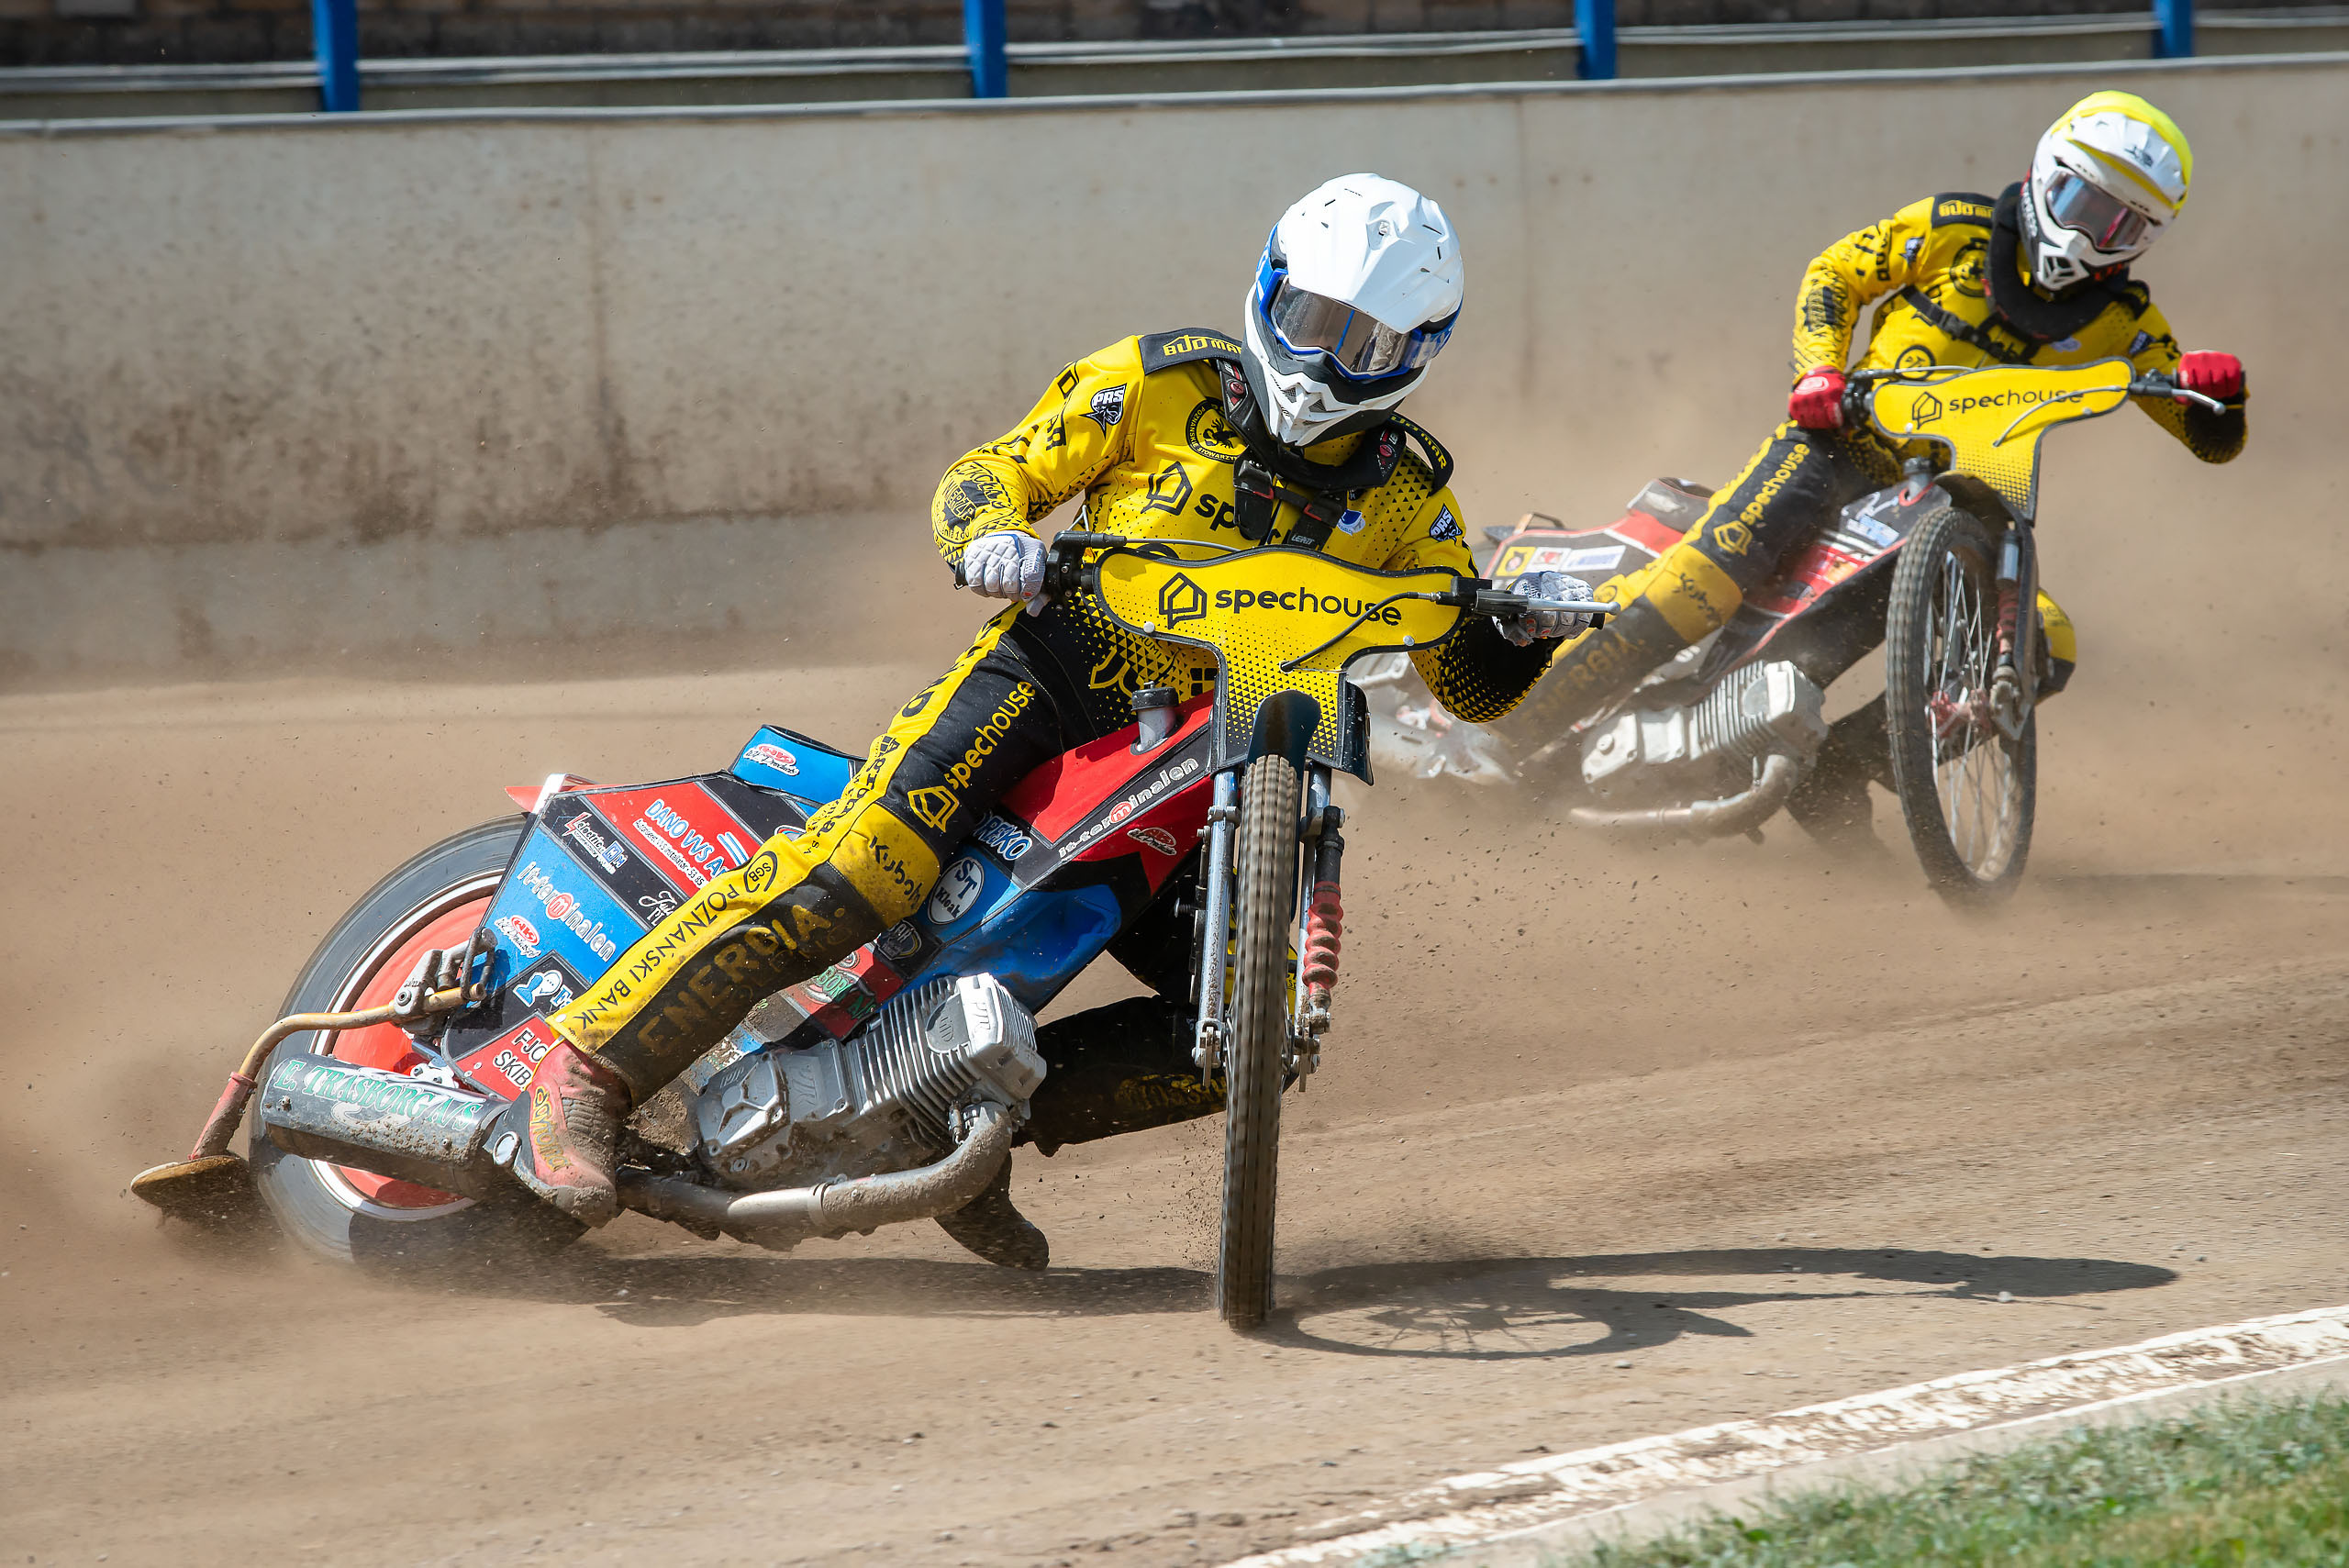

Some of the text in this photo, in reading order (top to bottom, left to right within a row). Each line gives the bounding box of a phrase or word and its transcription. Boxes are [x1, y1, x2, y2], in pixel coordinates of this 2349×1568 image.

[1949, 385, 2085, 413] spechouse
[1740, 442, 1809, 527] spechouse
[1215, 586, 1402, 626] spechouse
[943, 681, 1036, 791] spechouse
[644, 798, 689, 839] DANO
[680, 828, 715, 863] VVS
[935, 885, 961, 918] Kloak
[573, 973, 632, 1030] BANK
[303, 1064, 434, 1120] TRASBORG
